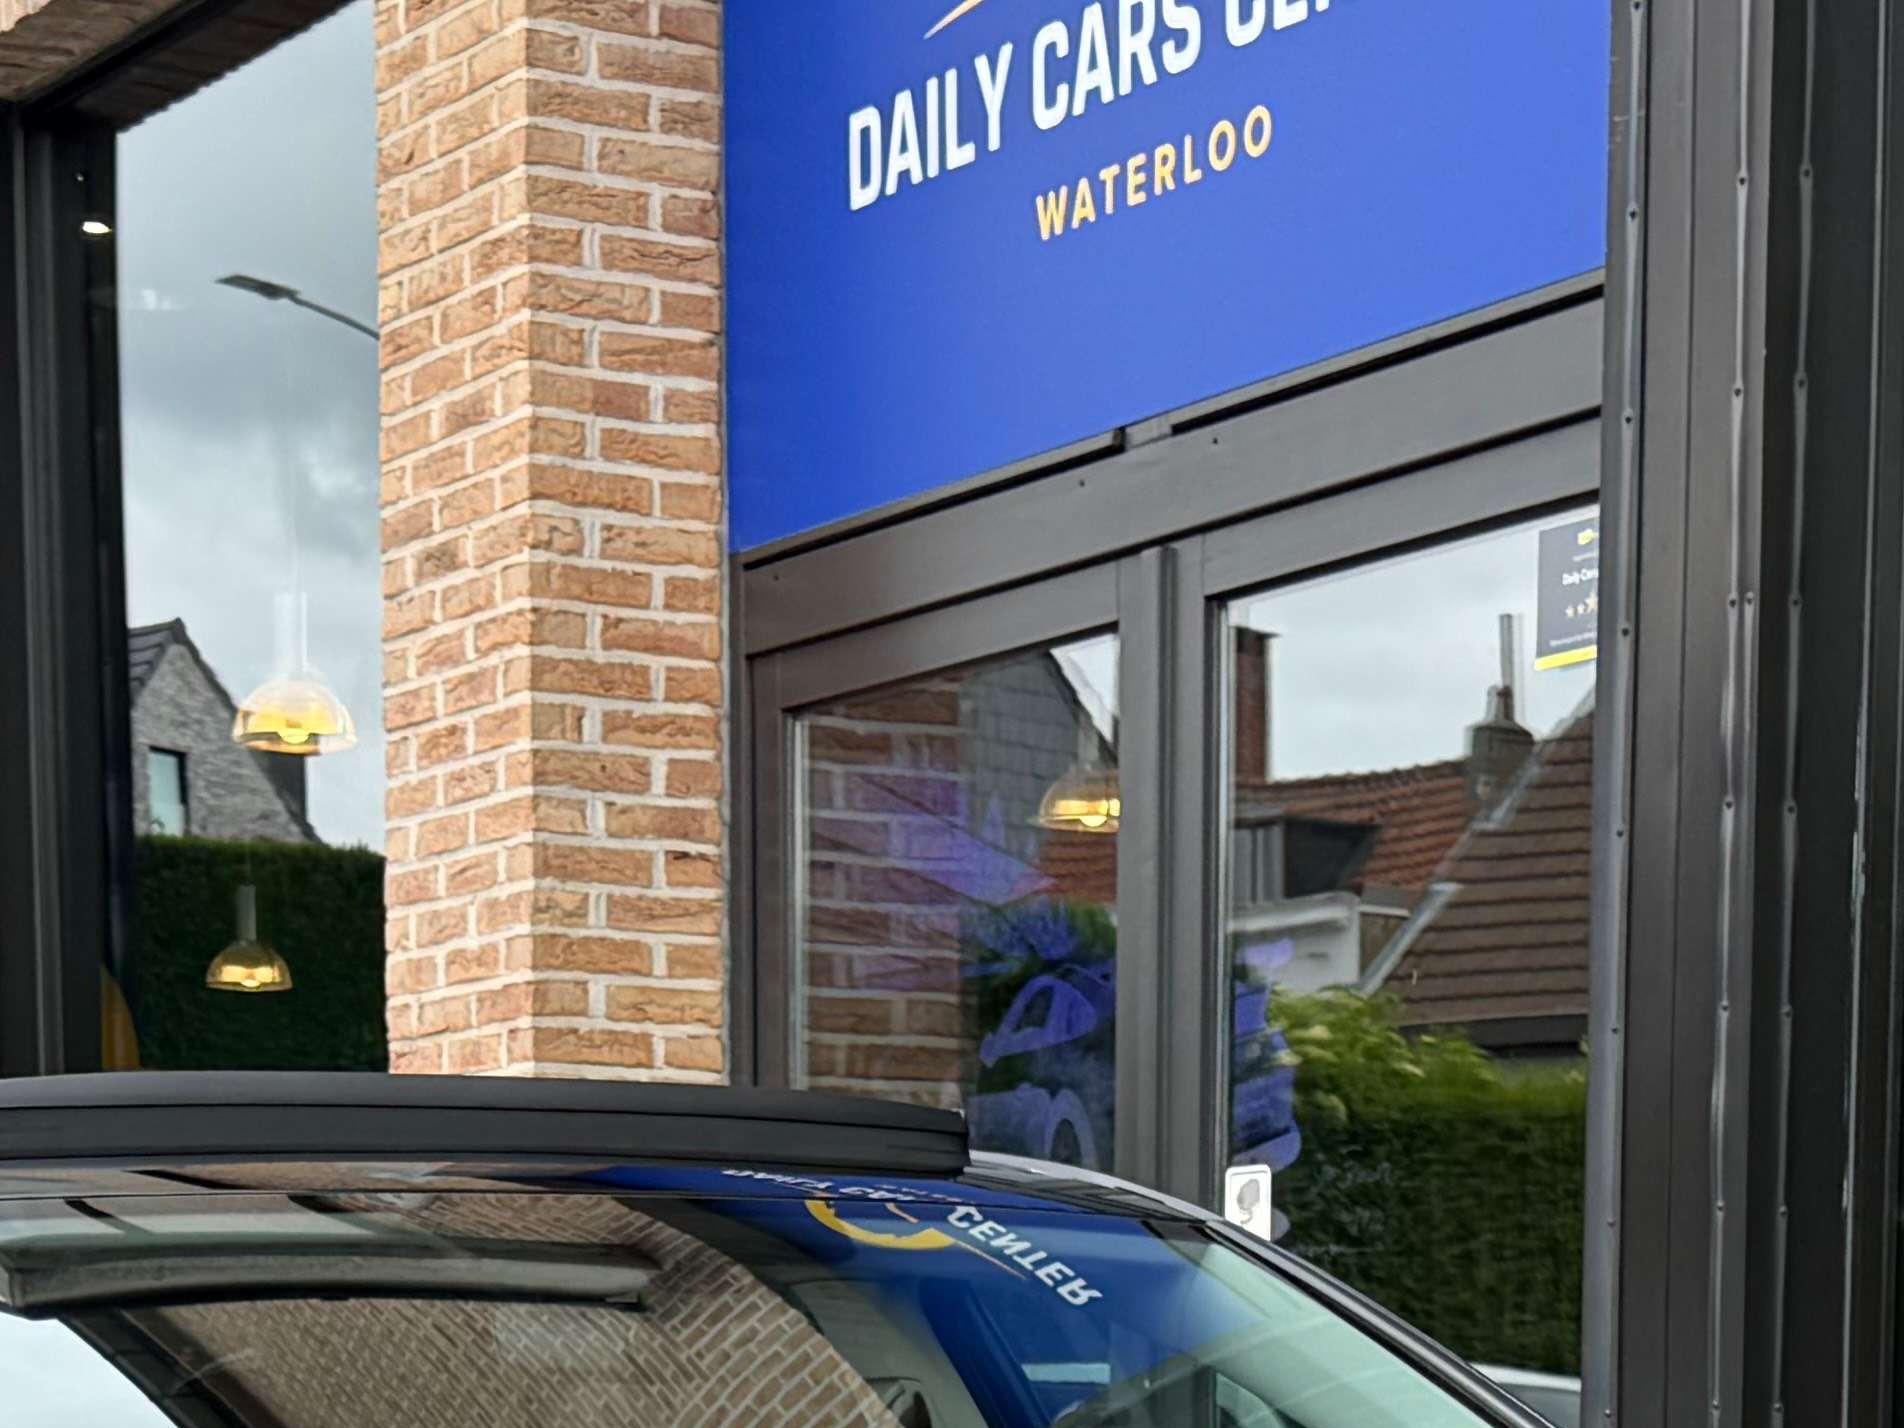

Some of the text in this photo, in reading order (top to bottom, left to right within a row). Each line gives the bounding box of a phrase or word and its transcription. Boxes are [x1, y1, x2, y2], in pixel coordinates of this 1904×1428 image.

[849, 0, 1201, 211] DAILY CARS
[1035, 105, 1272, 241] WATERLOO
